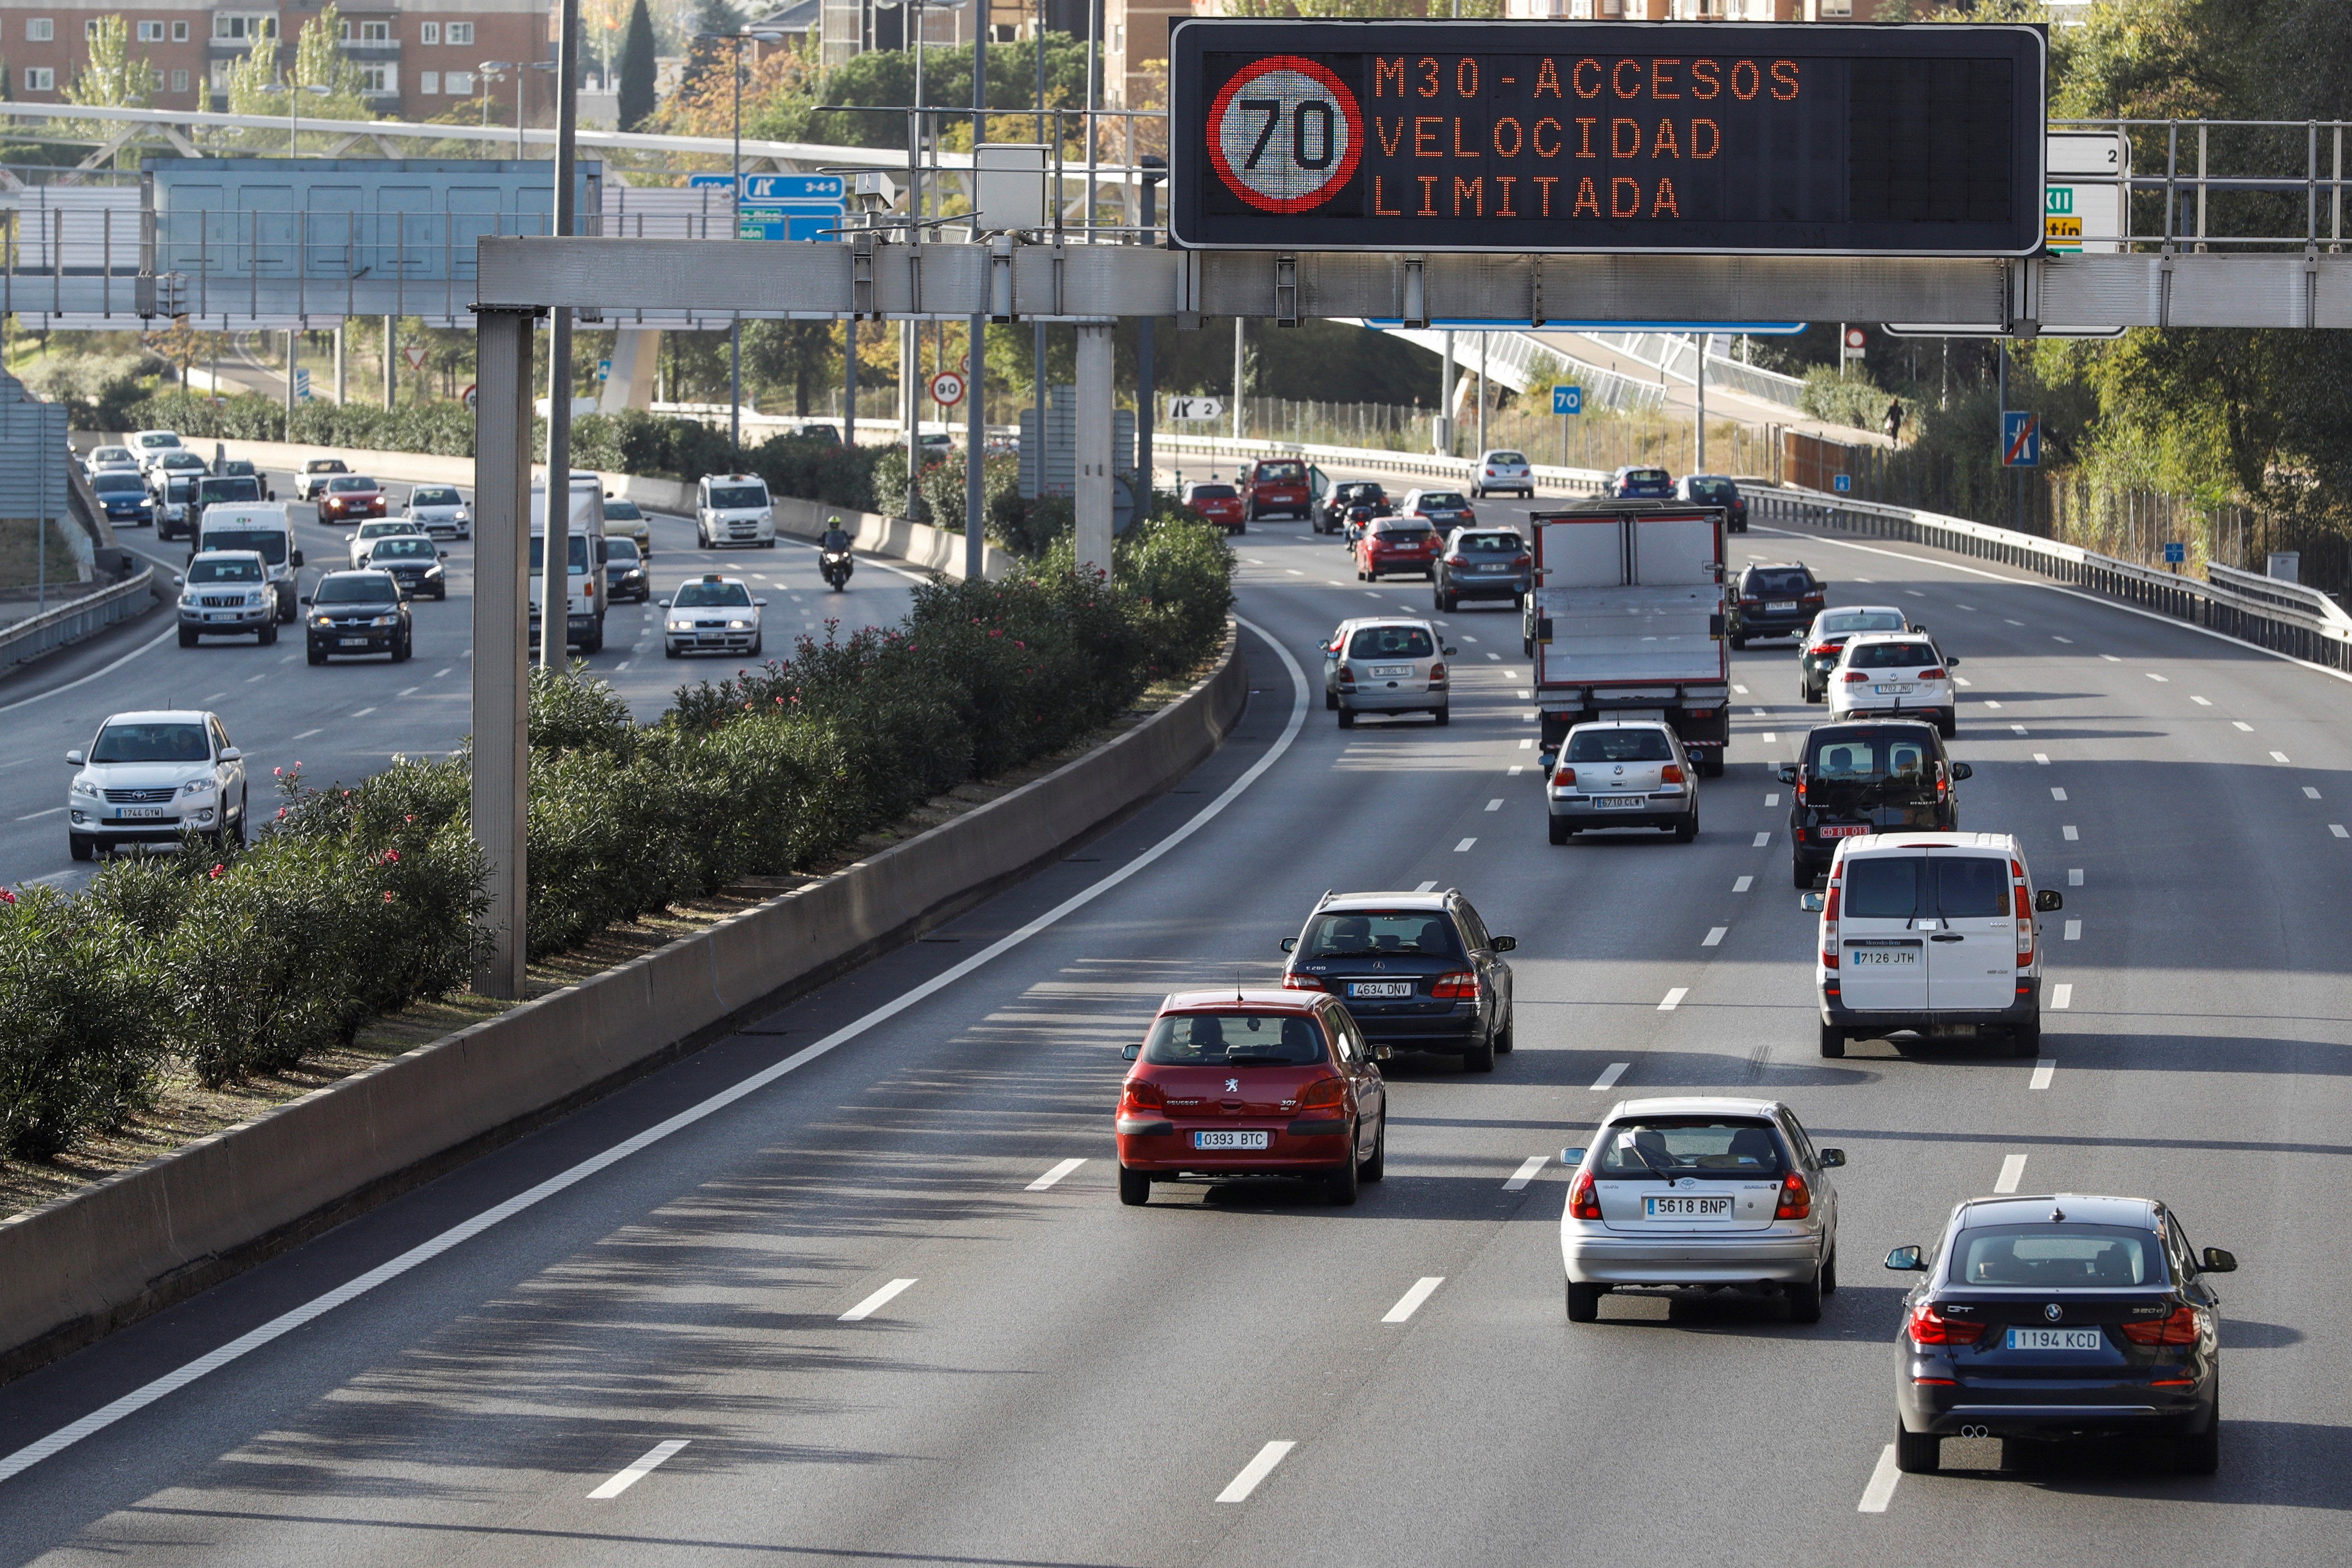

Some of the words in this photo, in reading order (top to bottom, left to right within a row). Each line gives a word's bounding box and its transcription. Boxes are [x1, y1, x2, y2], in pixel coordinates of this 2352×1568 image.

[1239, 100, 1334, 170] 70
[1375, 117, 1720, 159] VELOCIDAD
[2108, 149, 2117, 162] 2
[1375, 177, 1680, 217] LIMITADA
[938, 383, 957, 394] 90
[1556, 392, 1578, 407] 70
[1205, 403, 1213, 414] 2
[1602, 799, 1622, 807] 6710
[1822, 828, 1833, 836] CD
[1837, 828, 1847, 836] 81
[1861, 953, 1889, 964] 7126
[1894, 953, 1914, 963] JTH
[1357, 984, 1384, 995] 4634
[1388, 984, 1407, 994] DNV
[1204, 1133, 1233, 1145] 0393
[1241, 1133, 1263, 1145] BTC
[1659, 1199, 1694, 1213] 5618
[1700, 1200, 1727, 1214] BNP
[2022, 1332, 2060, 1347] 1194
[2066, 1333, 2096, 1348] KCD
